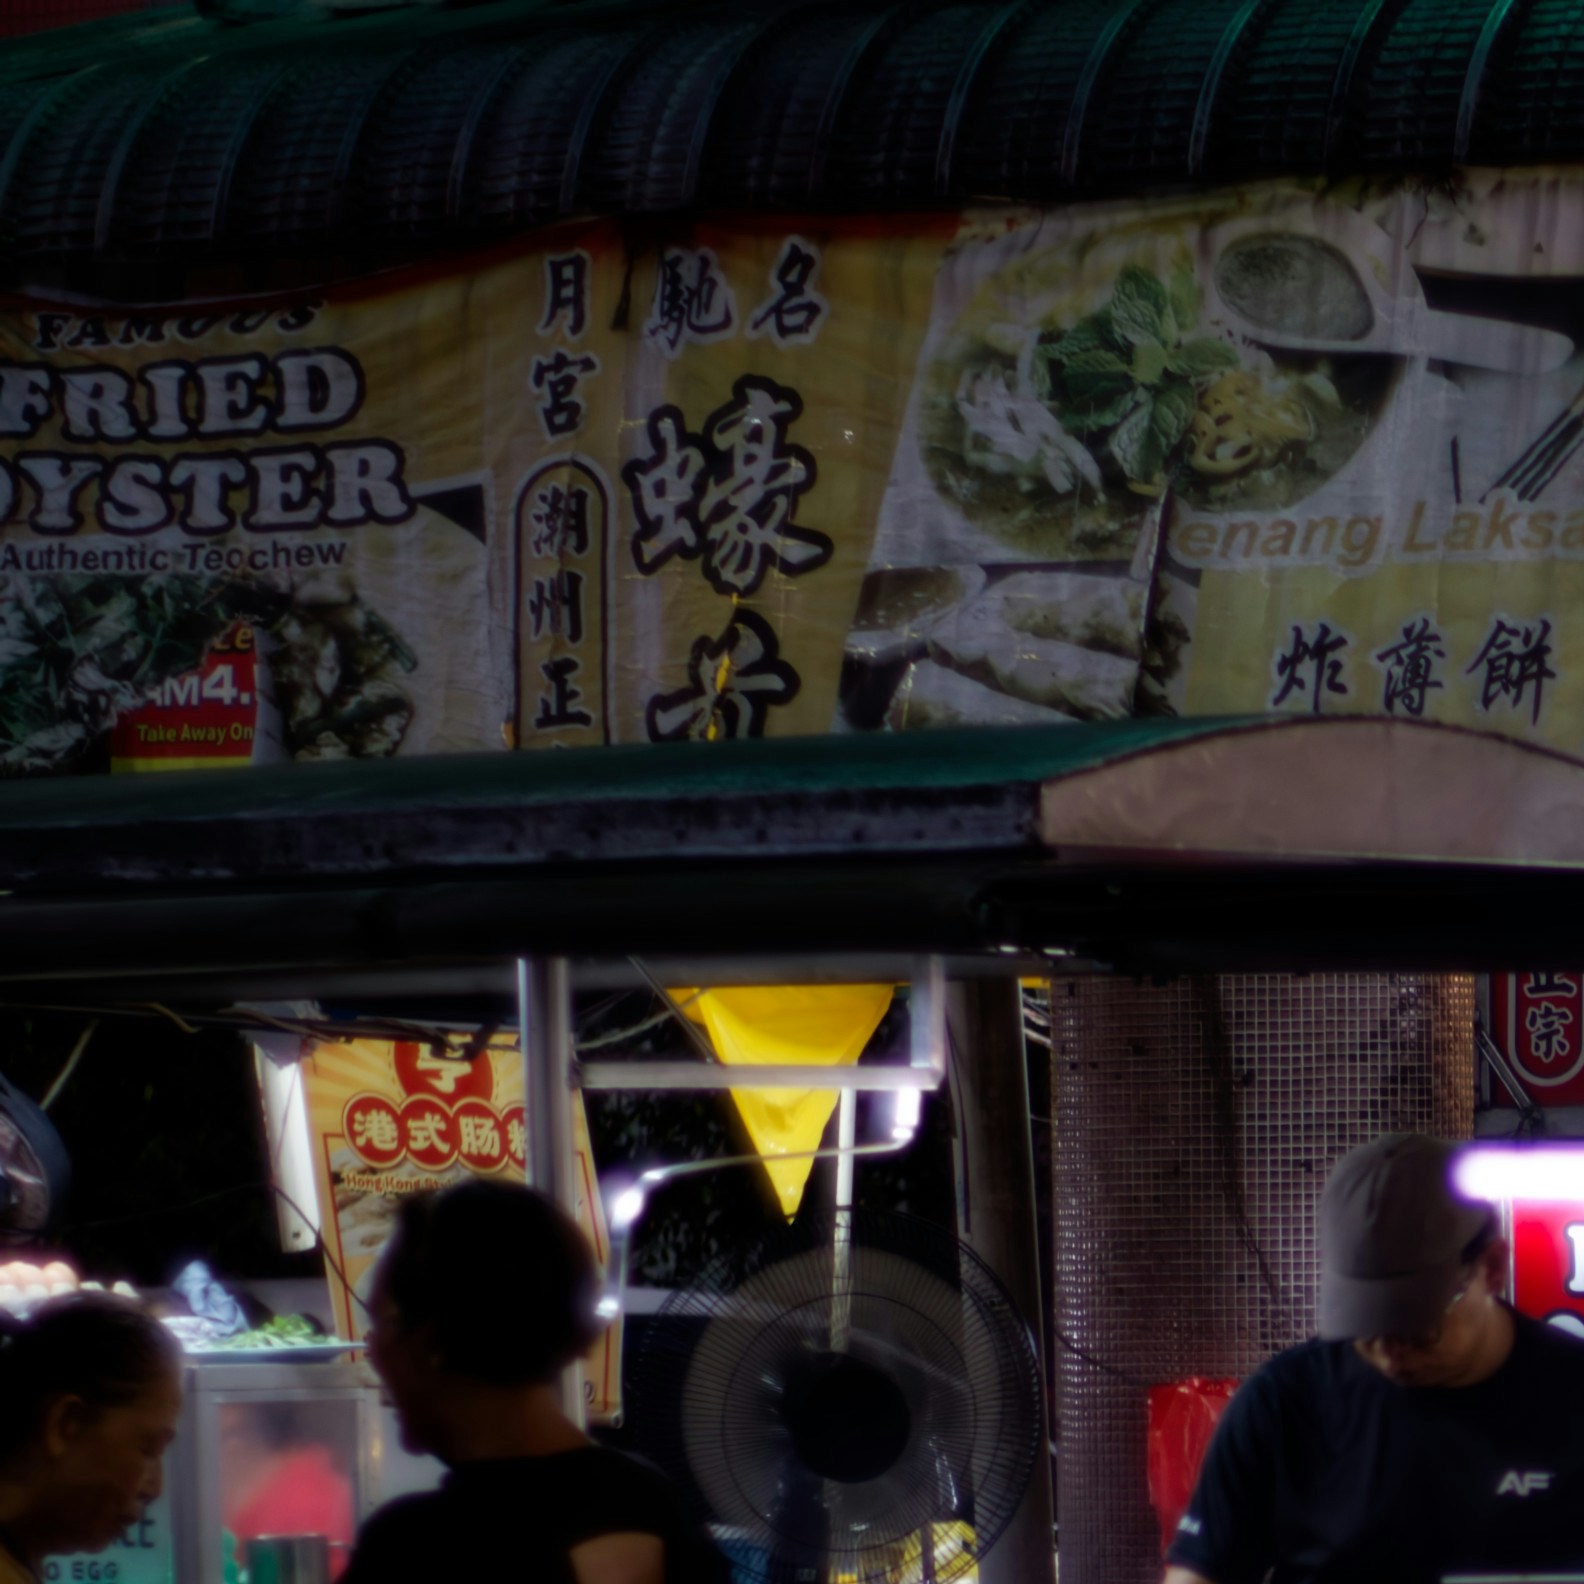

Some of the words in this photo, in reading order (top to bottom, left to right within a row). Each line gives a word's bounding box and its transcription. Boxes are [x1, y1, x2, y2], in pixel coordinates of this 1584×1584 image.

[0, 438, 416, 535] YSTER
[1176, 511, 1383, 566] enang
[0, 542, 169, 573] Authentic
[182, 540, 347, 571] Teochew
[137, 723, 177, 743] Take
[180, 723, 226, 746] Away
[72, 1560, 118, 1581] EGG
